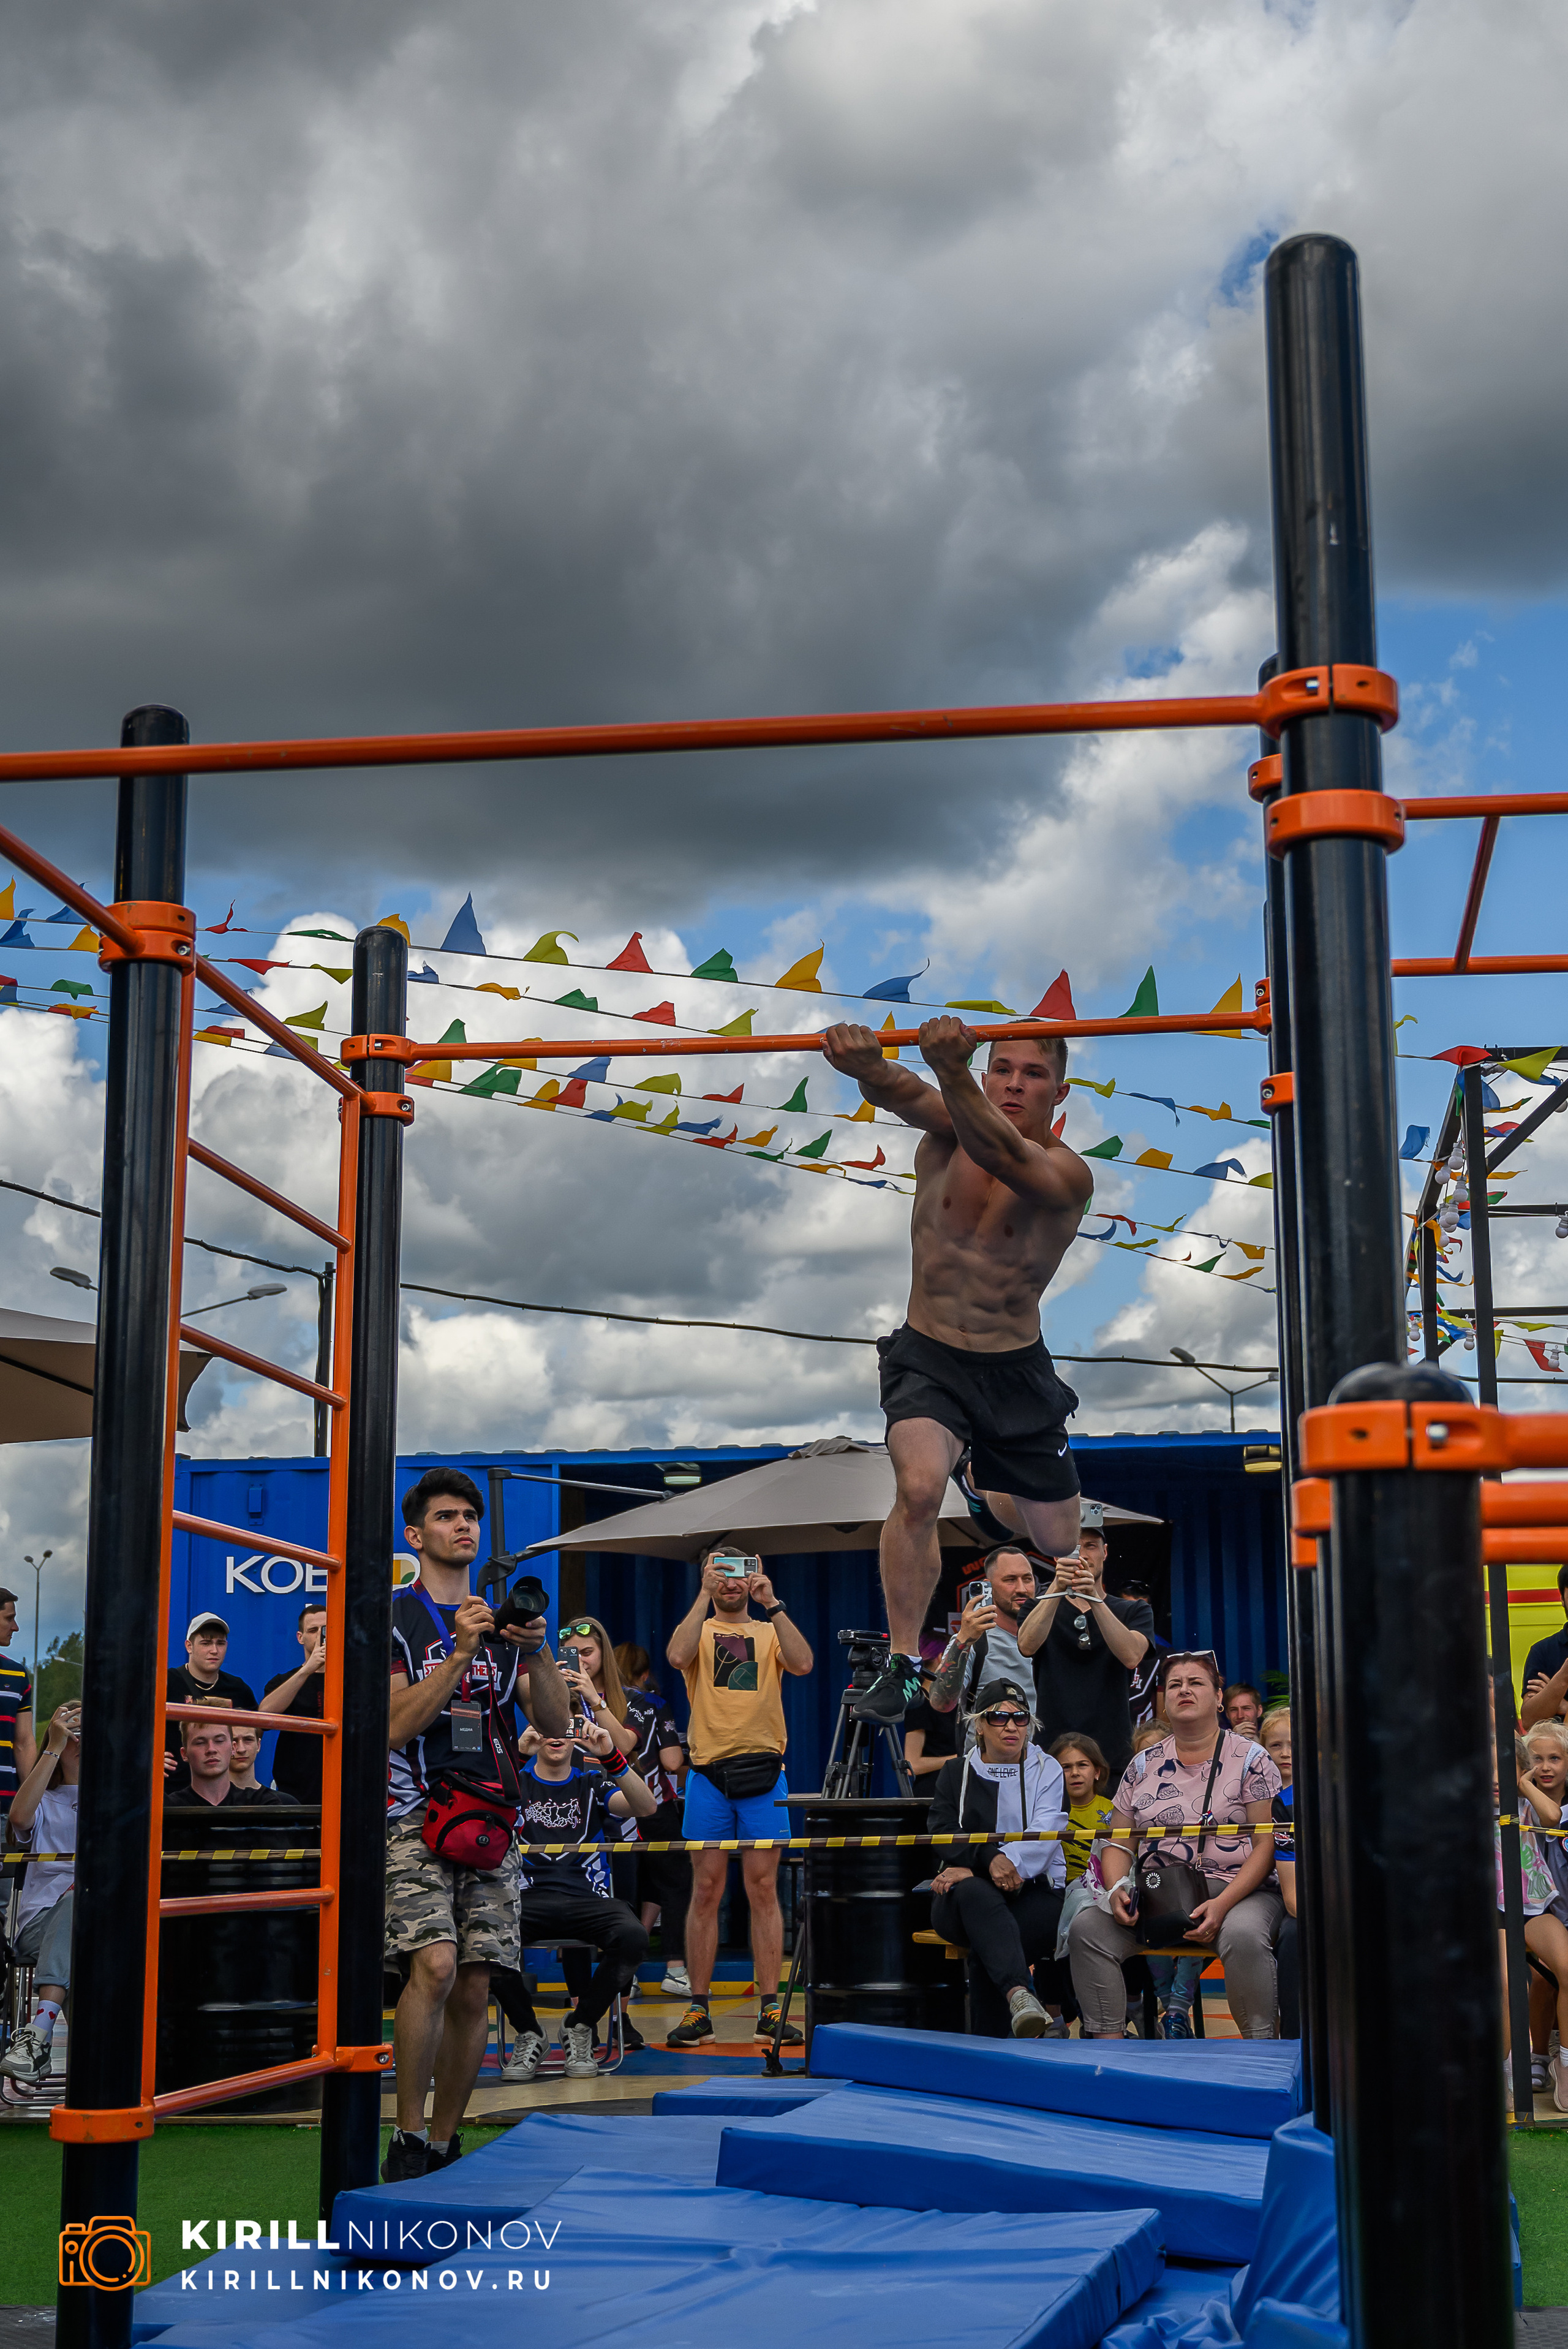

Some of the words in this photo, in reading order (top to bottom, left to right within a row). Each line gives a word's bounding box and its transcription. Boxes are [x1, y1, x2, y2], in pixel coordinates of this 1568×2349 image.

[493, 1738, 503, 1754] EOS
[988, 1767, 999, 1777] ONE
[1000, 1768, 1017, 1778] LEVEL
